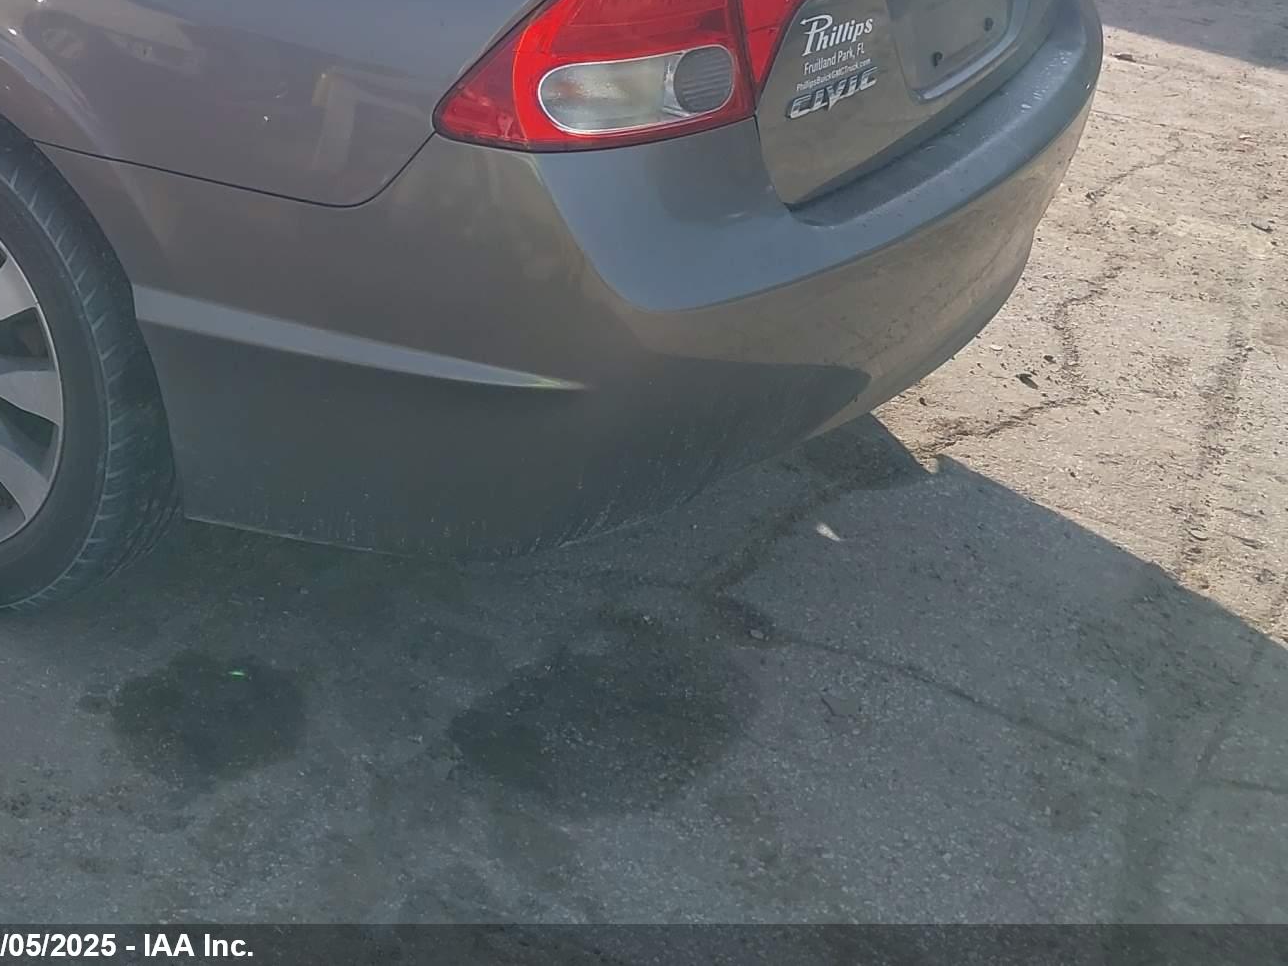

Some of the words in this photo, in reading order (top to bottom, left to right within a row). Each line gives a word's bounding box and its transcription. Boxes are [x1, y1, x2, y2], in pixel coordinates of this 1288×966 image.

[800, 14, 874, 56] Phillips
[803, 52, 837, 75] Fruitland
[837, 46, 856, 63] Park,
[856, 42, 865, 57] FL
[790, 66, 878, 119] CIVIC
